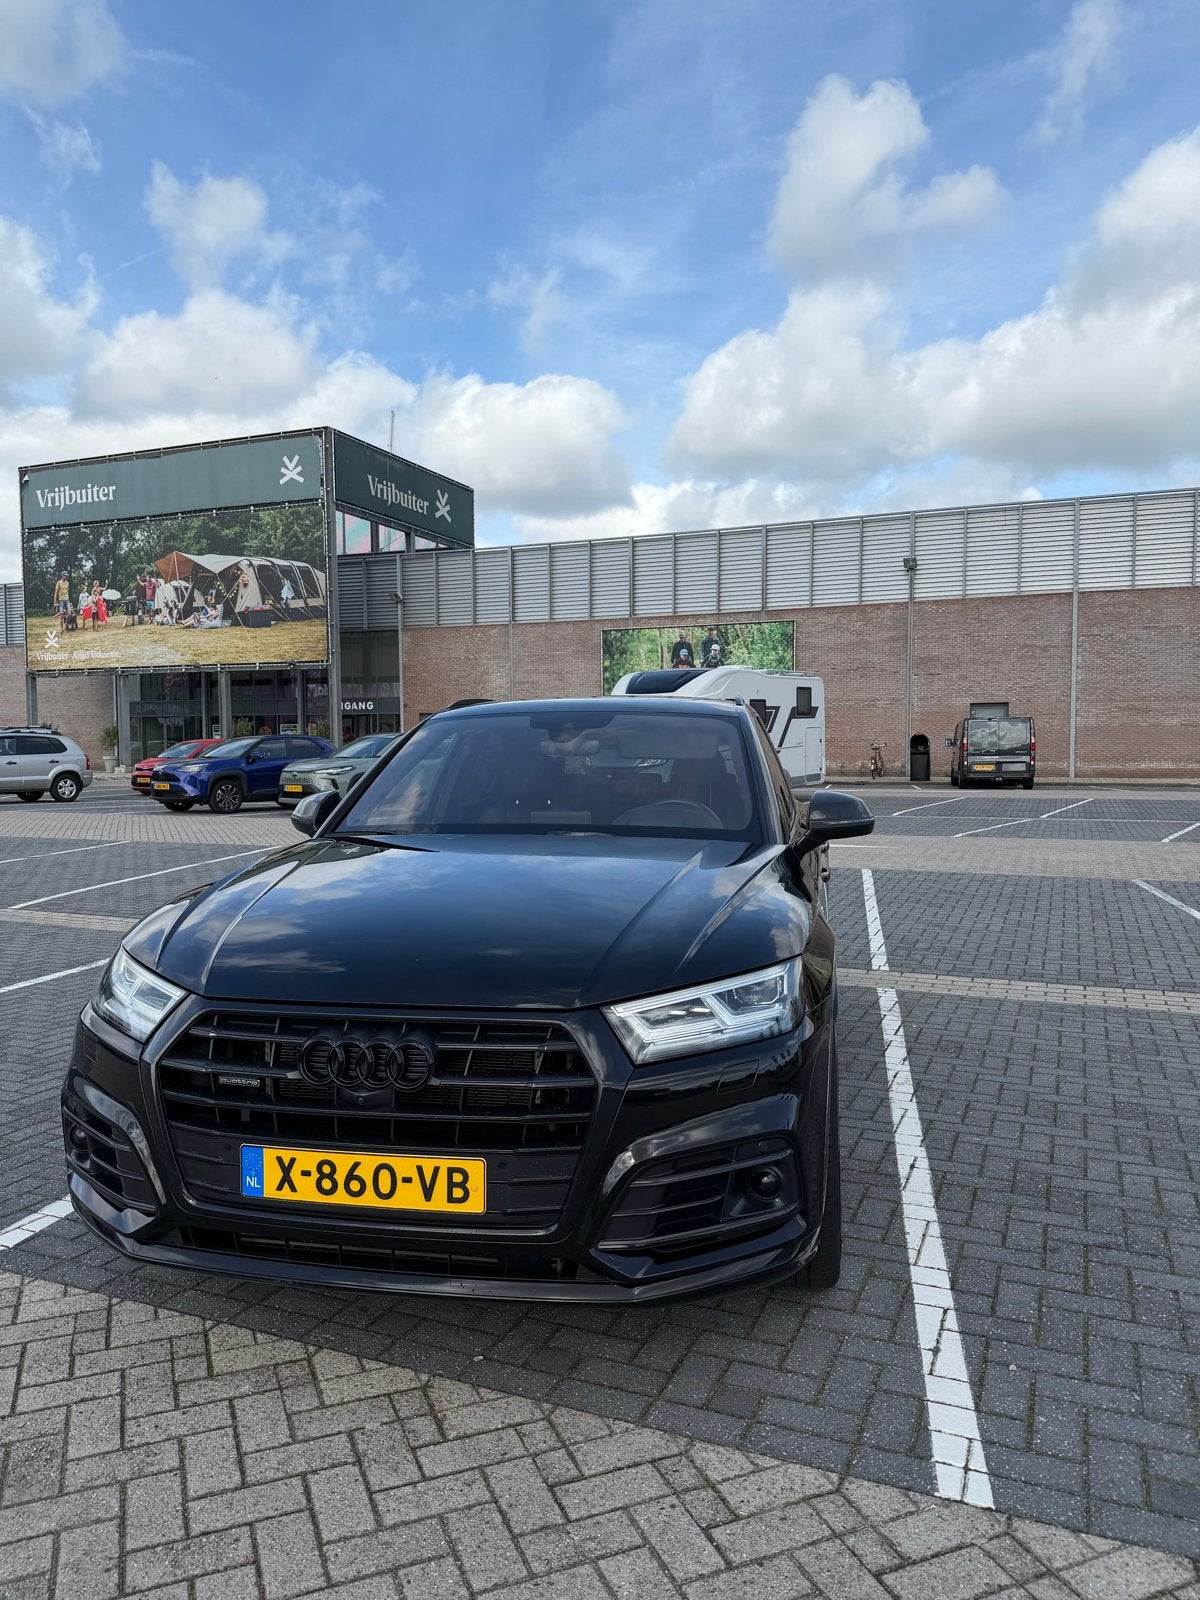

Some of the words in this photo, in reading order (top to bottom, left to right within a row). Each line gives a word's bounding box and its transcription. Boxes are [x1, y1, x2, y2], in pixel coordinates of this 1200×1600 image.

[35, 483, 117, 512] Vrijbuiter
[368, 474, 430, 516] Vrijbuiter
[36, 651, 69, 661] Vrijbuiter
[246, 1176, 261, 1188] NL
[275, 1156, 471, 1204] X-860-VB
